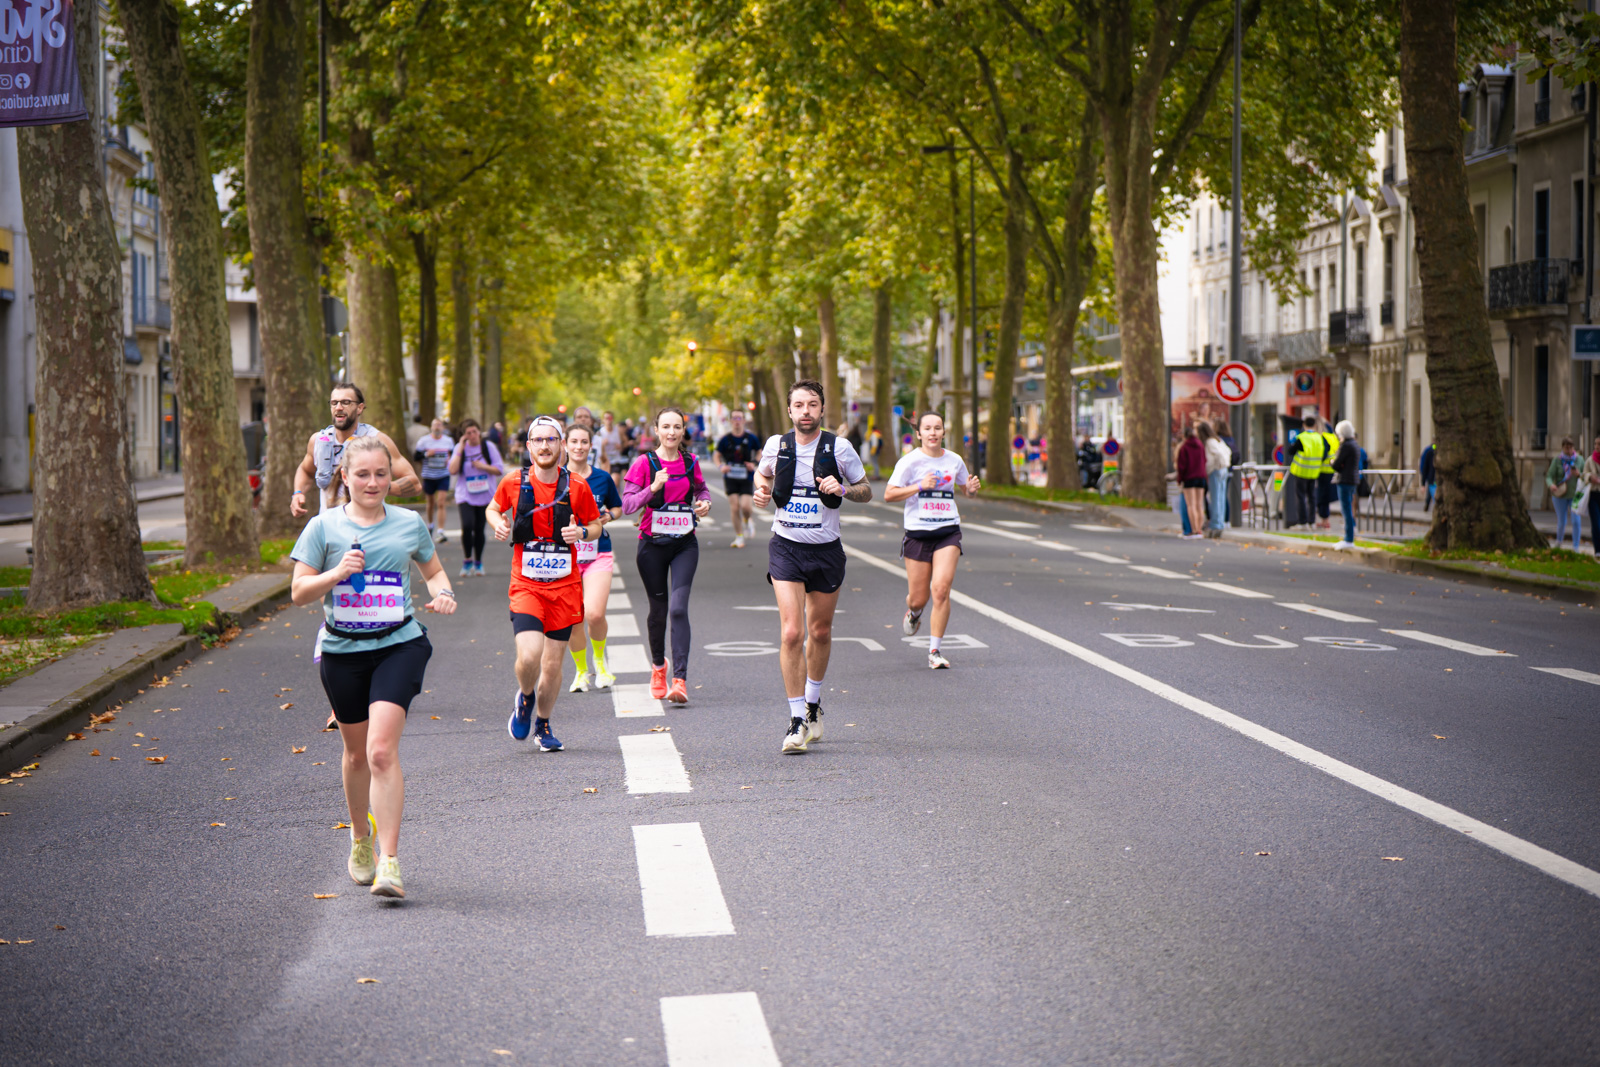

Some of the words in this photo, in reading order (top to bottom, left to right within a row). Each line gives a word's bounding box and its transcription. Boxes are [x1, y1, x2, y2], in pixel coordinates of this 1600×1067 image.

[922, 502, 951, 511] 43402
[656, 516, 689, 526] 42110
[576, 543, 594, 552] 375
[527, 557, 567, 569] 42422
[340, 593, 396, 608] 52016
[1100, 633, 1397, 651] BUS
